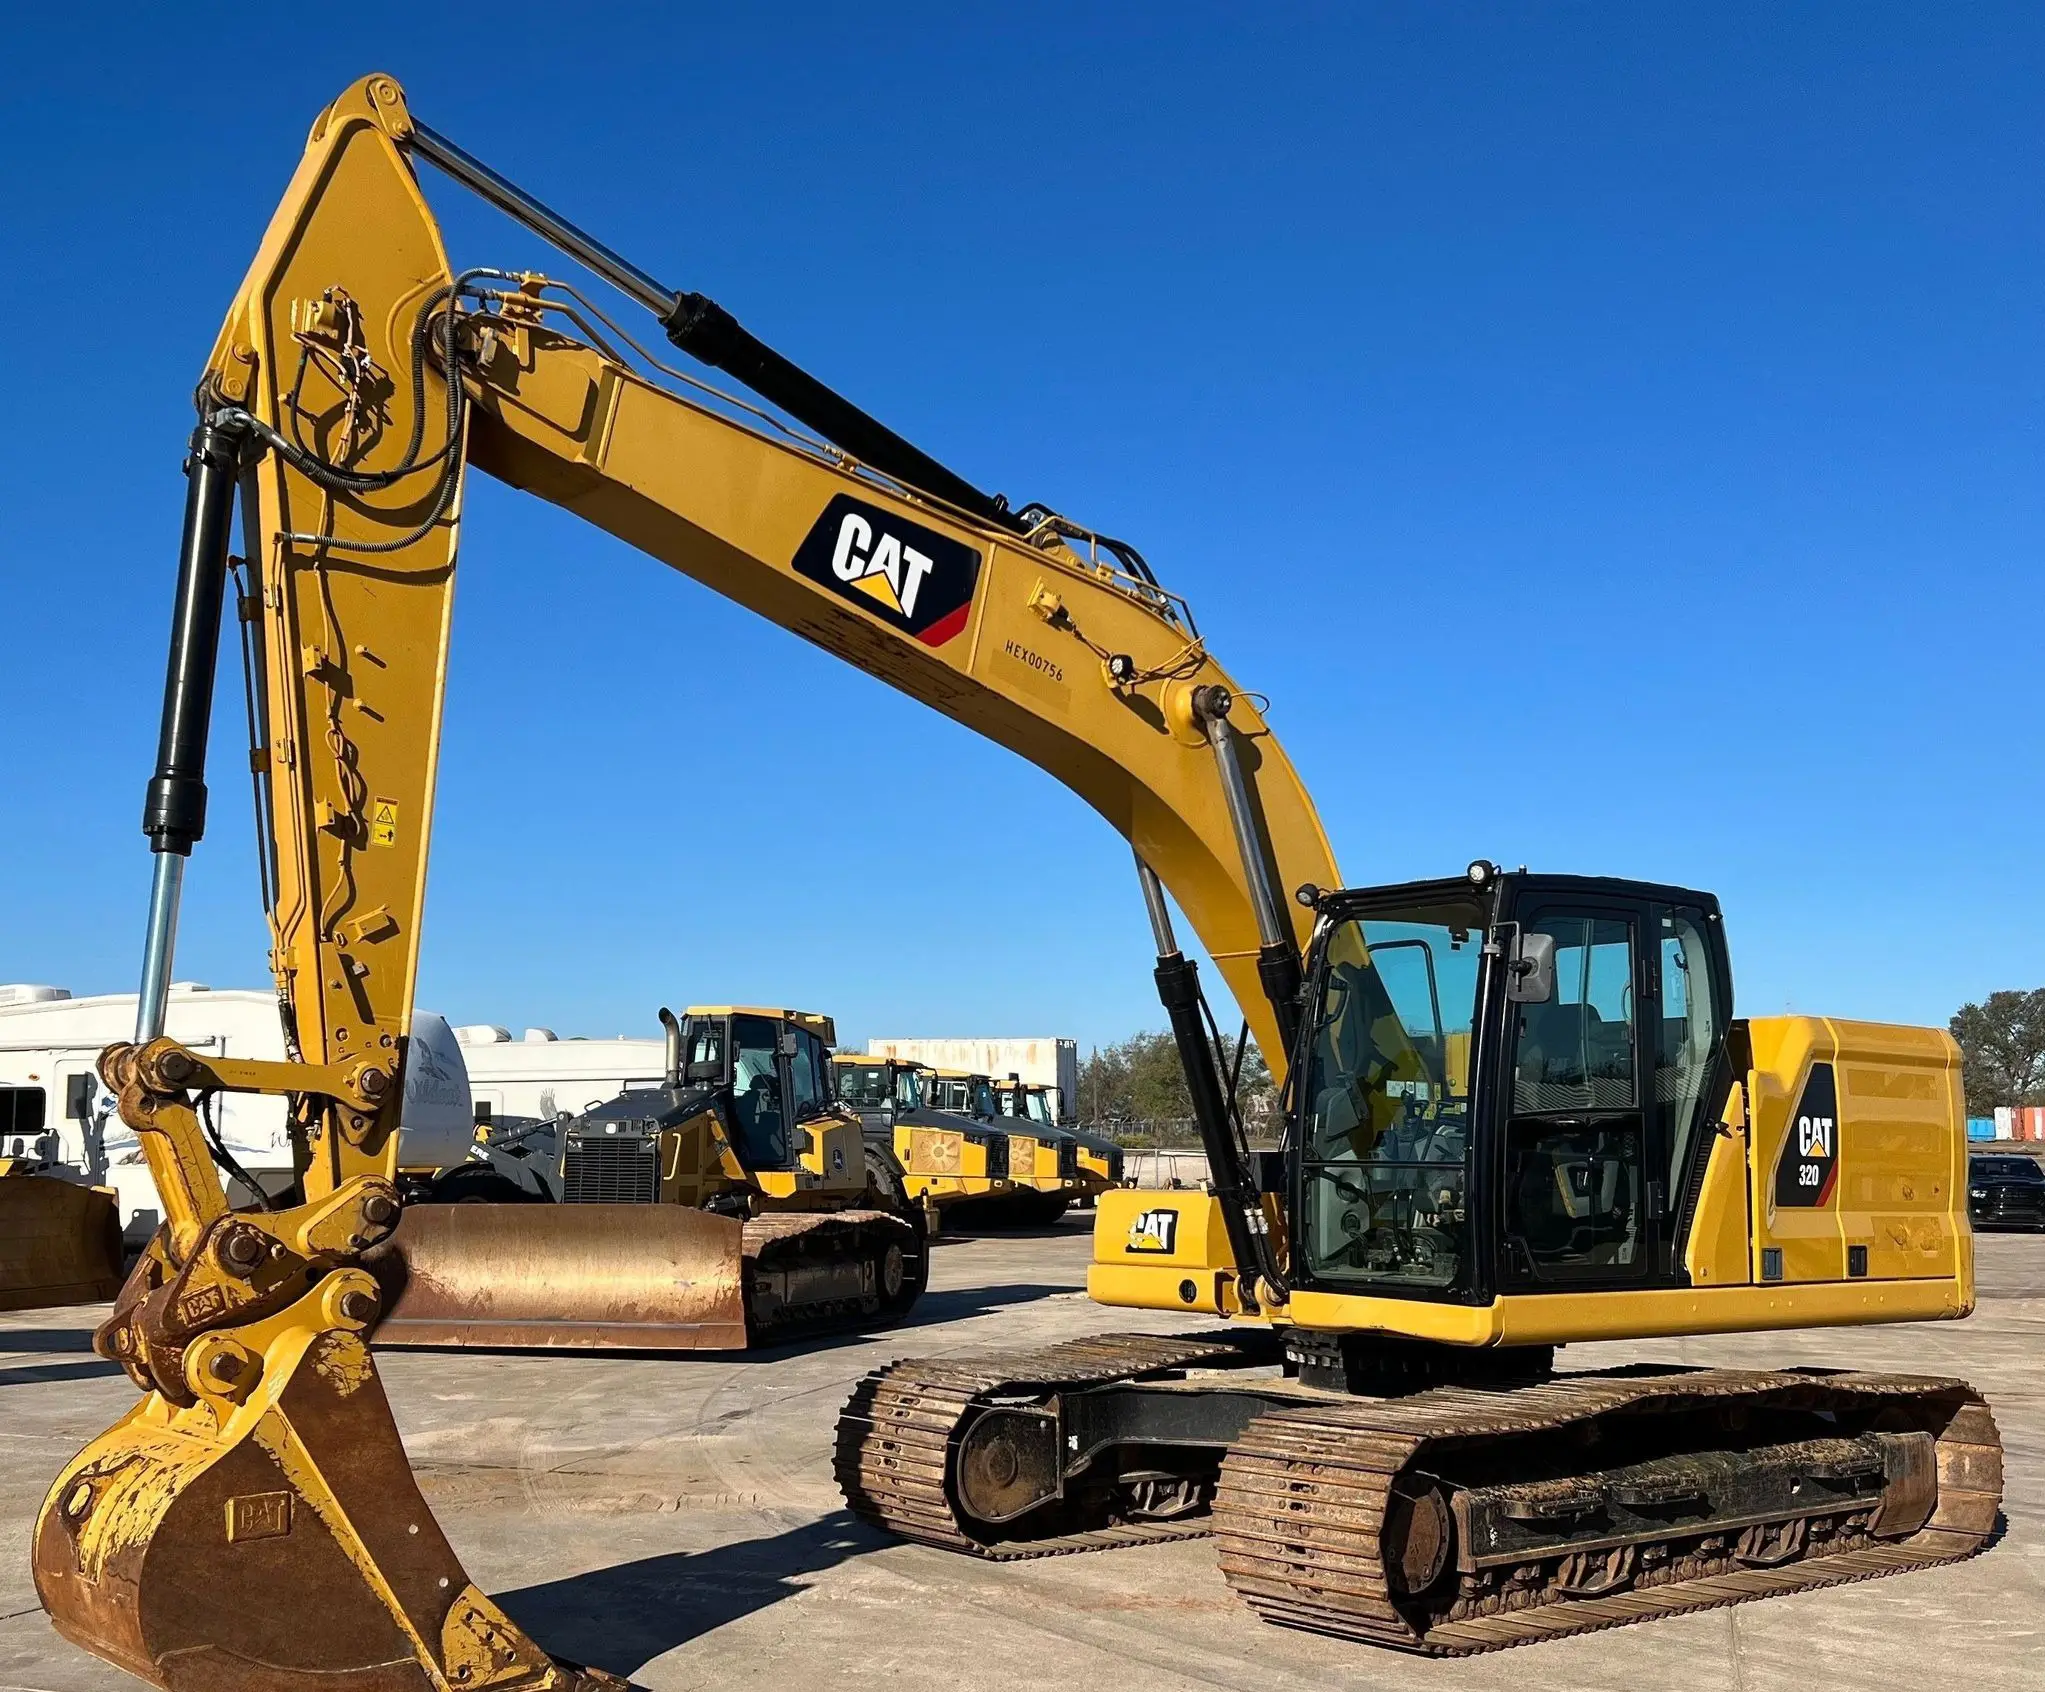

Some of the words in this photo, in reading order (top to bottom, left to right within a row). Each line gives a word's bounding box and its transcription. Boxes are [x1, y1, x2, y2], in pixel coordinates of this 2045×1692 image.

[832, 513, 933, 618] CAT
[1005, 639, 1063, 682] HEX00756
[1799, 1116, 1832, 1157] CAT
[1799, 1165, 1819, 1186] 320
[1129, 1213, 1173, 1249] CAT
[187, 1290, 219, 1318] CAT
[241, 1500, 285, 1533] CAT
